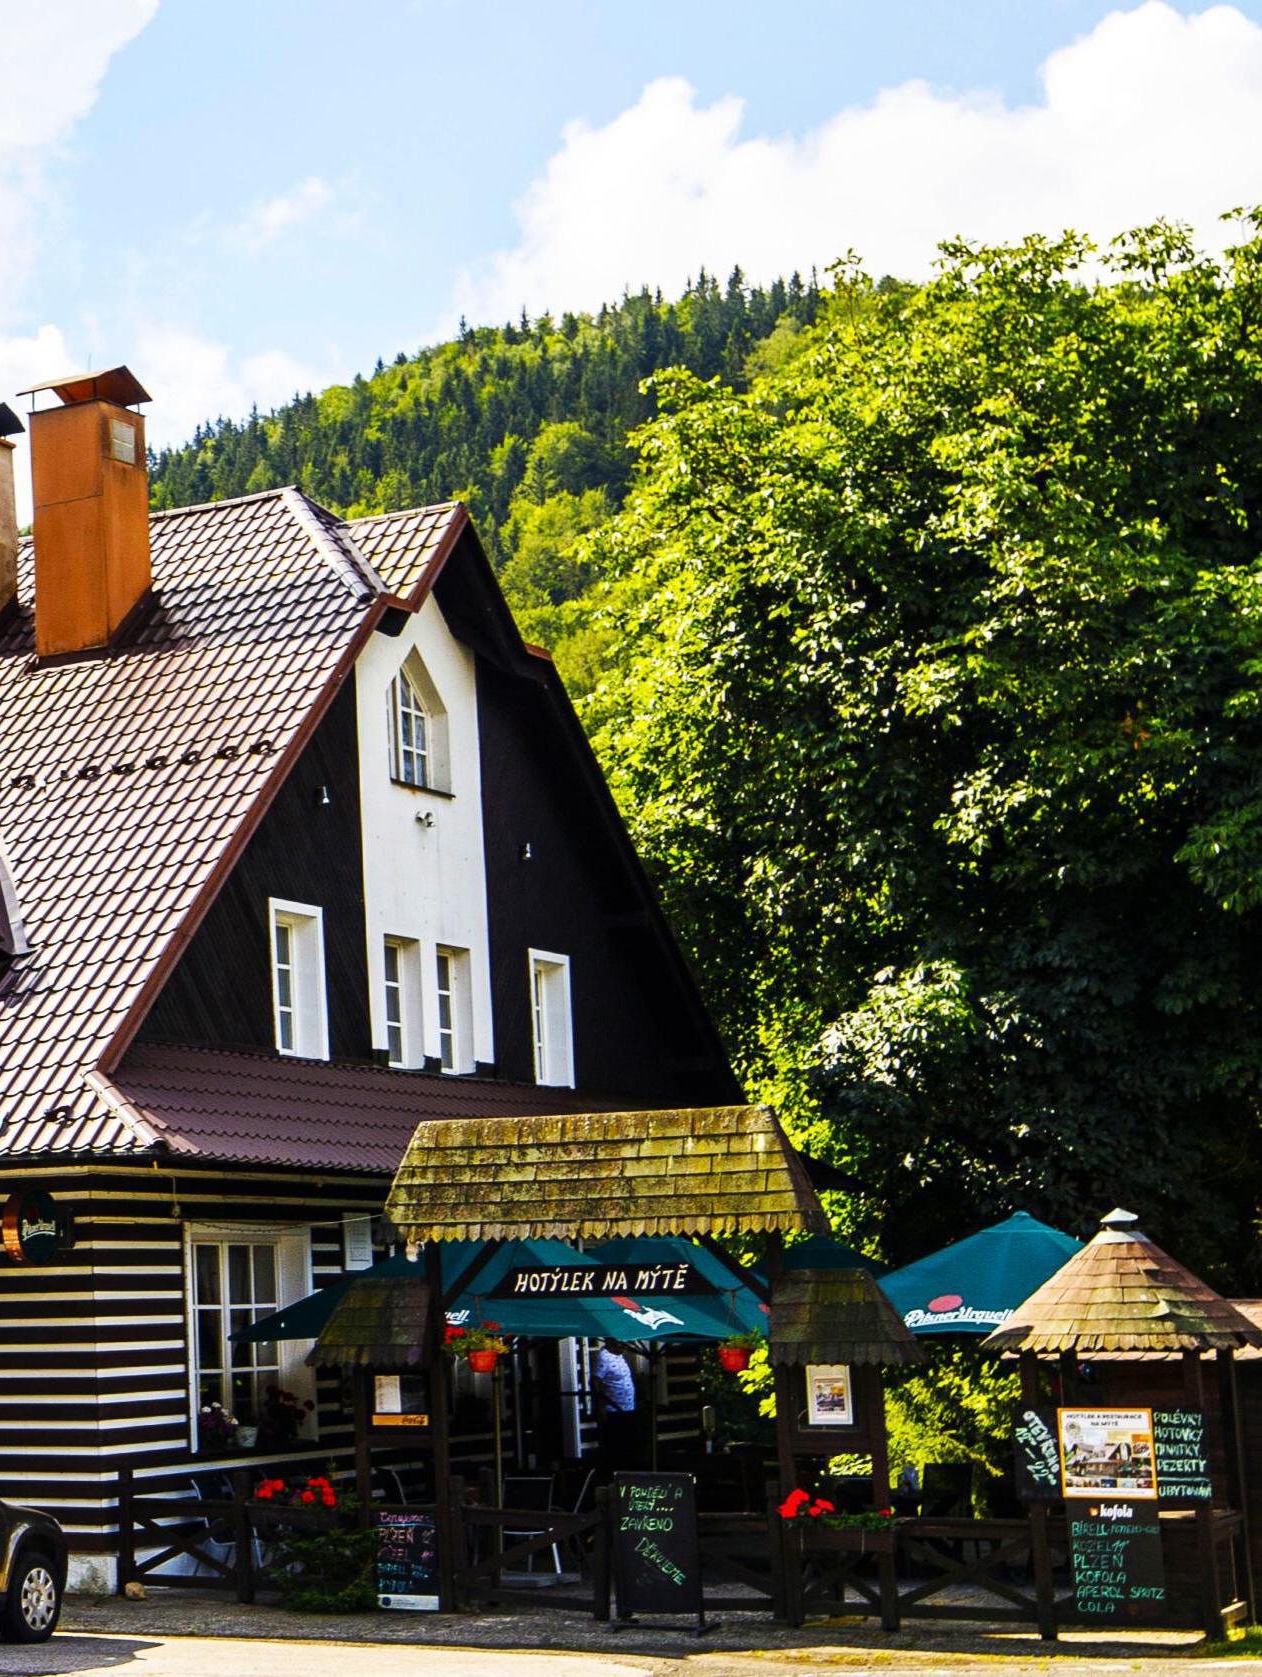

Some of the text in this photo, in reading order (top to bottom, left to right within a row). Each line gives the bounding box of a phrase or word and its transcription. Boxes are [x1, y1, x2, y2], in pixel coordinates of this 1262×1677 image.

[514, 1263, 690, 1293] HOTÝLEK NA MÝTĚ
[903, 1308, 959, 1328] Pilsner
[1153, 1409, 1202, 1426] POLÉVKY
[1022, 1410, 1060, 1473] OTEVŘENO
[1156, 1457, 1207, 1473] DEZERTY
[619, 1485, 626, 1498] V
[674, 1487, 683, 1499] A
[1099, 1503, 1134, 1521] kofola
[620, 1515, 674, 1532] ZAVŘENO
[1075, 1570, 1127, 1584] KOFOLA
[1076, 1585, 1126, 1599] APEROL
[1077, 1601, 1116, 1613] COLA
